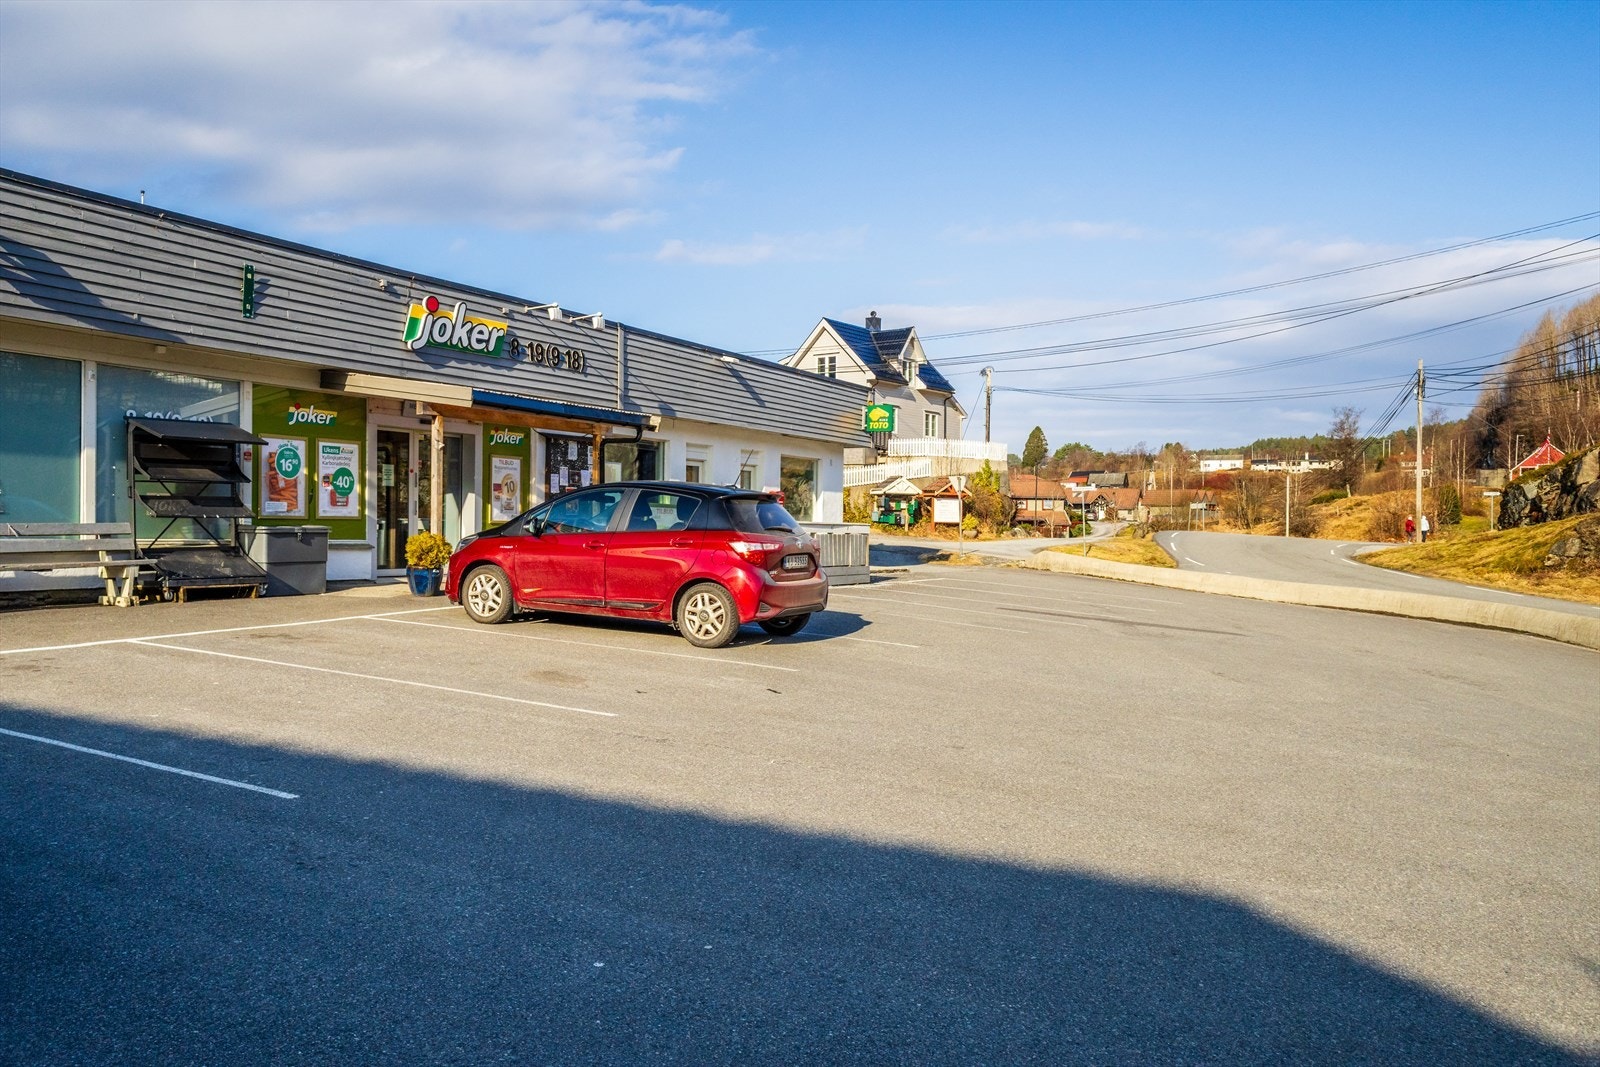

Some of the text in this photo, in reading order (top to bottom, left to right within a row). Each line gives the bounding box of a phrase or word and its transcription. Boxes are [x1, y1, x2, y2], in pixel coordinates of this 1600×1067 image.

[408, 296, 505, 352] joker
[288, 403, 334, 426] joker
[869, 421, 889, 429] TOTO
[490, 427, 522, 446] joker
[504, 480, 515, 493] 10
